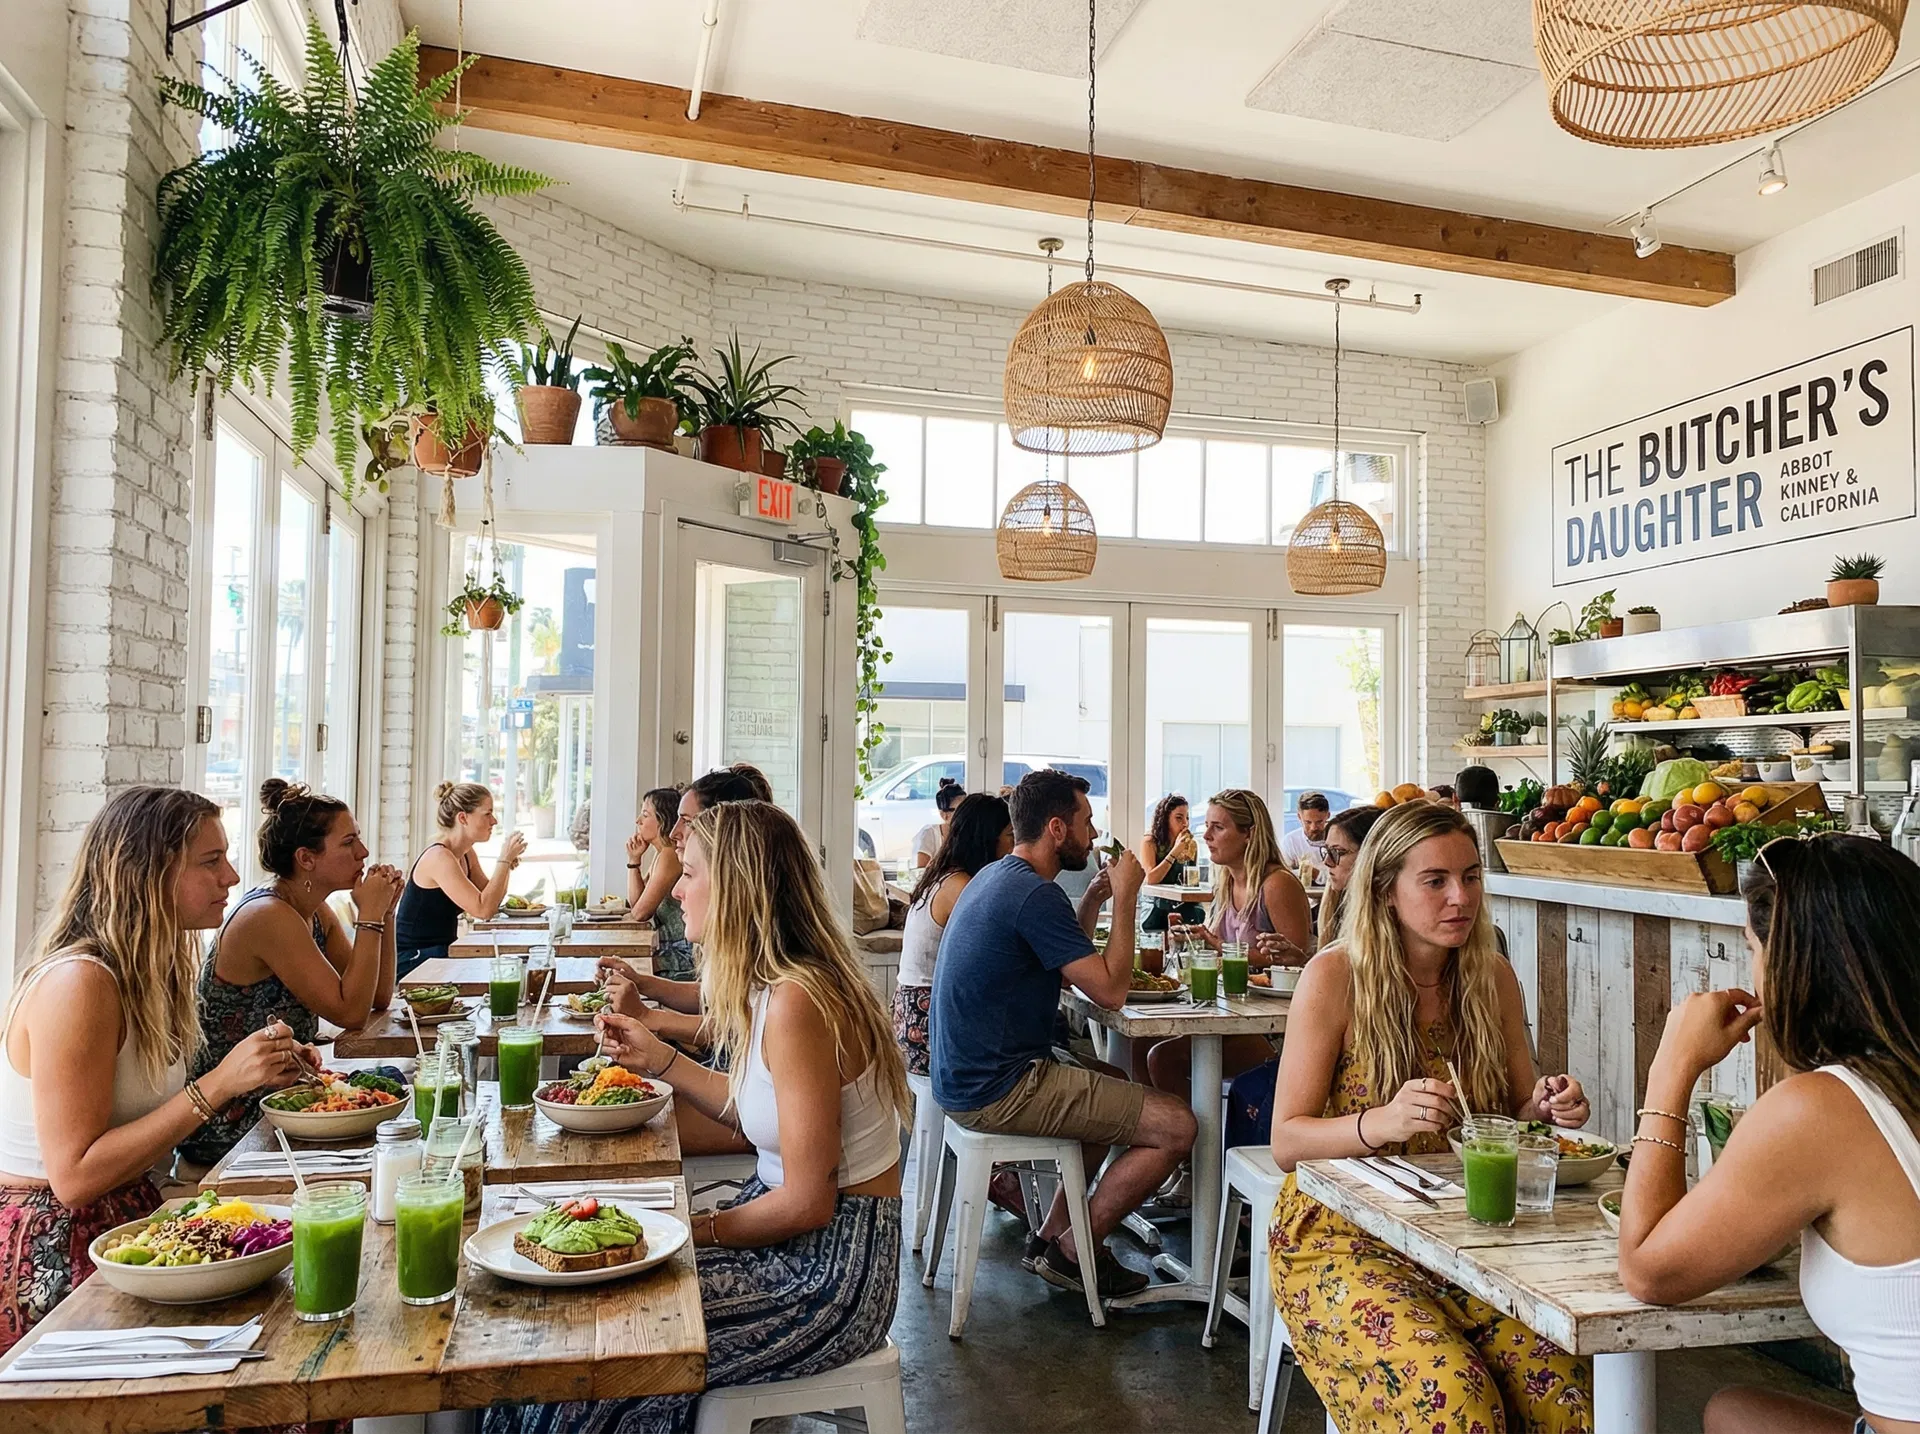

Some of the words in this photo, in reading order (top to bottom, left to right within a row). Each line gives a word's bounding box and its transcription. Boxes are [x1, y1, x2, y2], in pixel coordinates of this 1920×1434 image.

[1564, 442, 1624, 507] THE
[1639, 359, 1889, 488] BUTCHER'S
[1780, 450, 1833, 479] ABBOT
[758, 478, 793, 520] EXIT
[1780, 473, 1839, 501] KINNEY
[1846, 468, 1859, 485] &
[1567, 471, 1763, 567] DAUGHTER
[1780, 486, 1879, 523] CALIFORNIA
